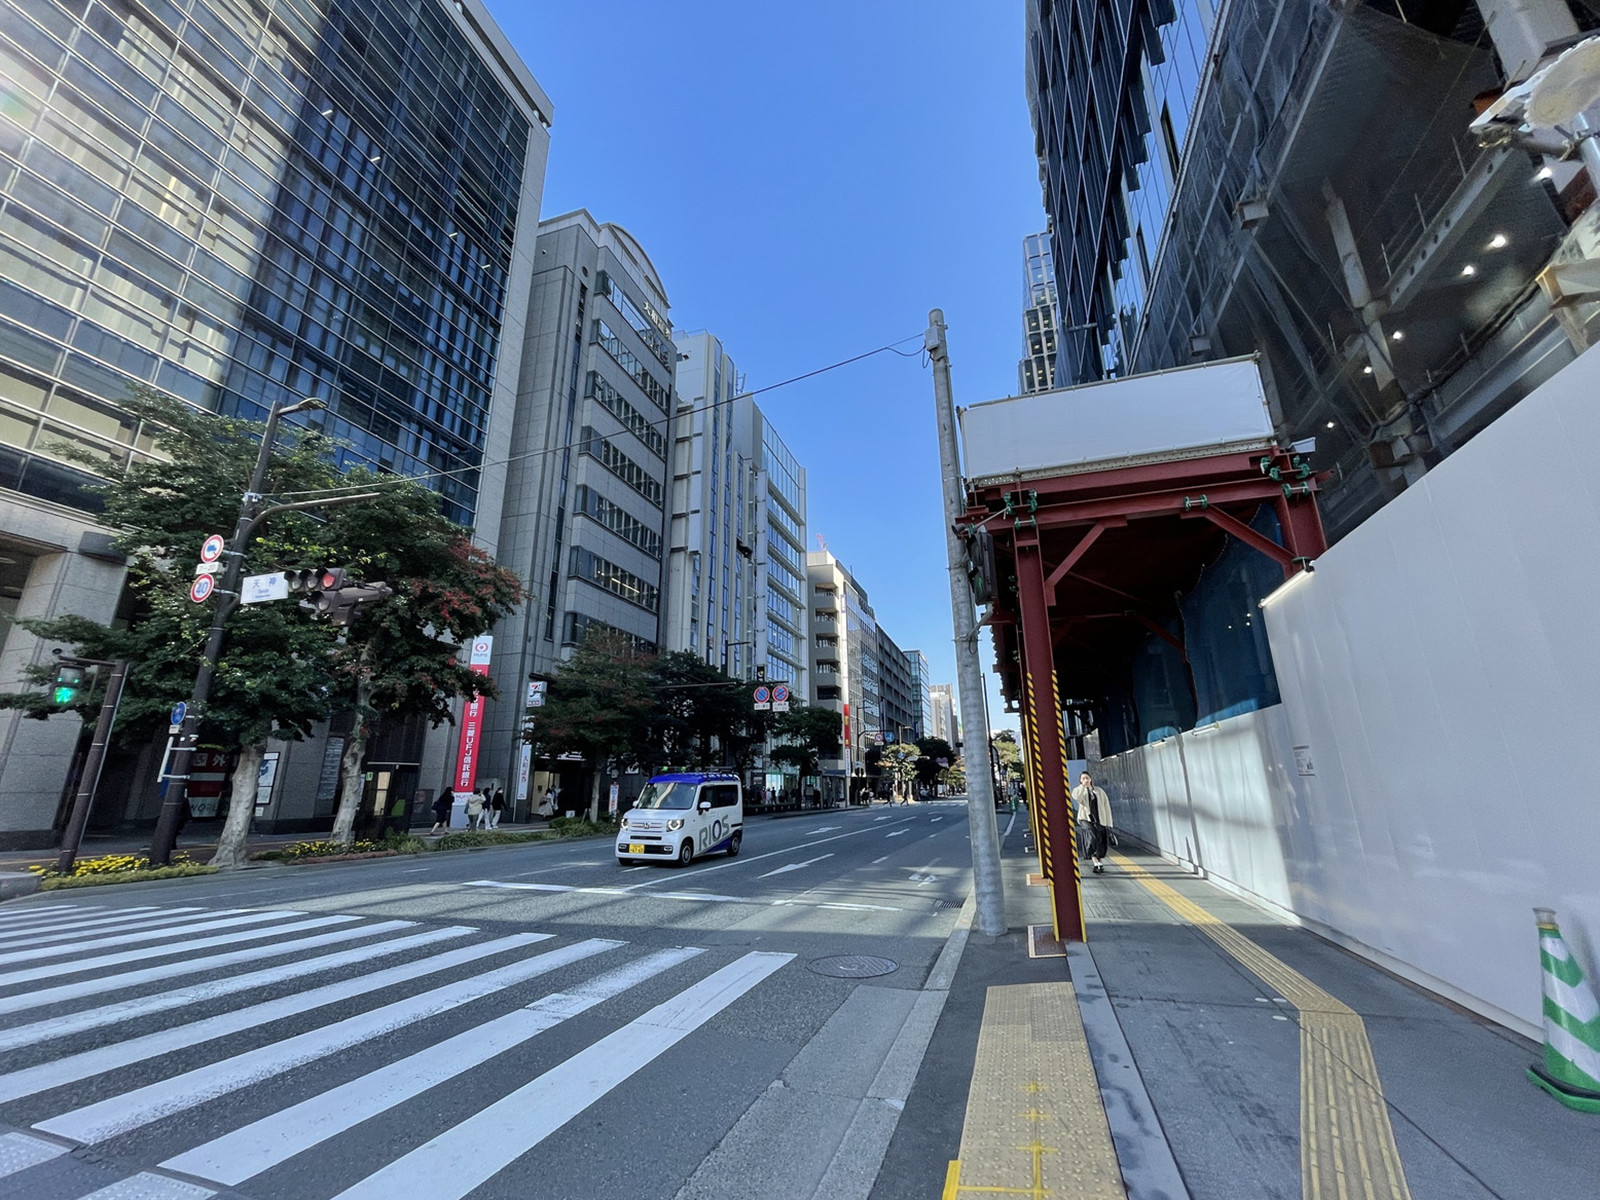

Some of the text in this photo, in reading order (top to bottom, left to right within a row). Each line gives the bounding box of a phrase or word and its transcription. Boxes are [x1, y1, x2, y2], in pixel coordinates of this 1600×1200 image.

[195, 581, 209, 593] 40
[252, 576, 277, 588] 天神
[698, 814, 730, 851] RIOS
